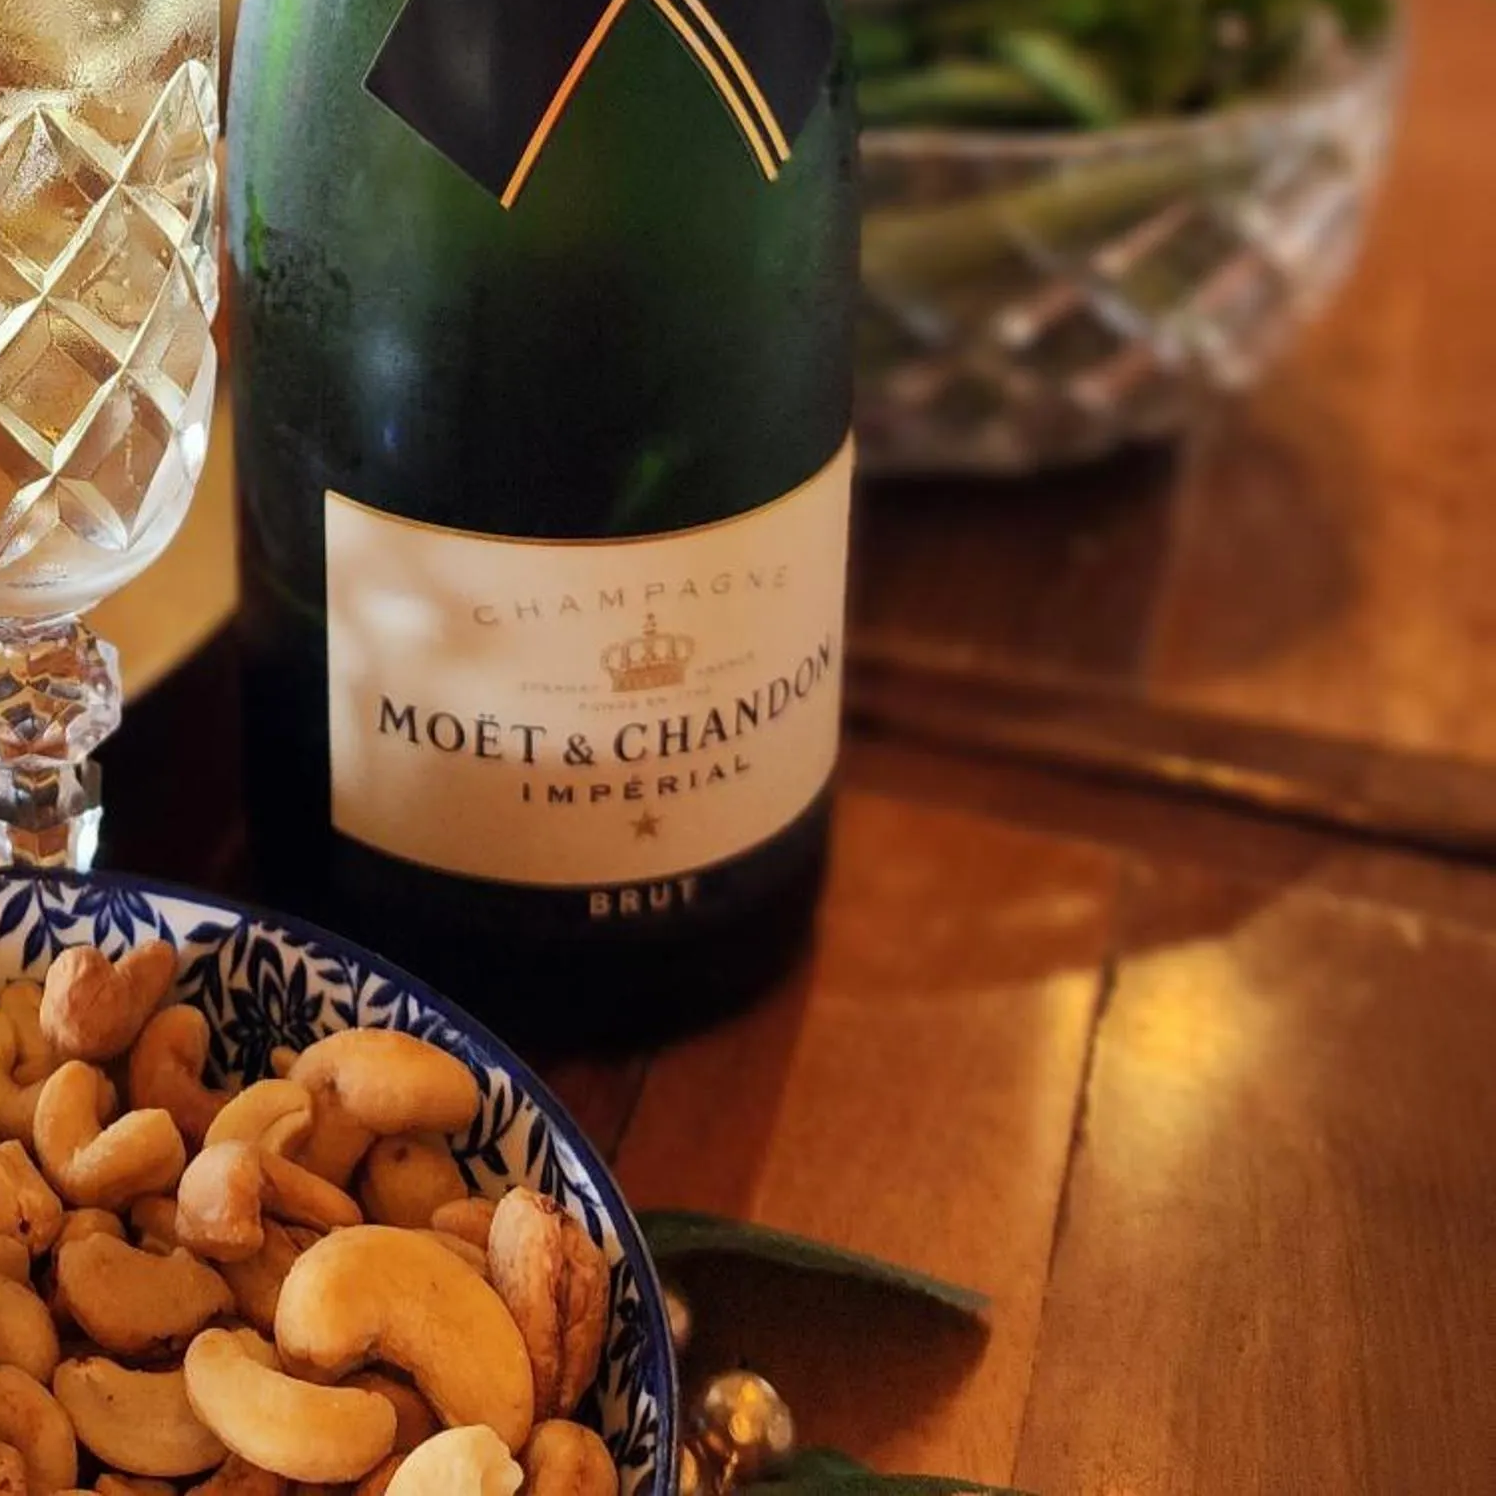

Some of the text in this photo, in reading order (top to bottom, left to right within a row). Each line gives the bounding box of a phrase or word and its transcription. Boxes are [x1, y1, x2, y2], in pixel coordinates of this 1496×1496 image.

[472, 564, 790, 628] CHAMPAGNE
[378, 632, 832, 767] MOËT & CHANDON
[522, 755, 753, 804] IMPÉRIAL
[589, 878, 698, 916] BRUT
